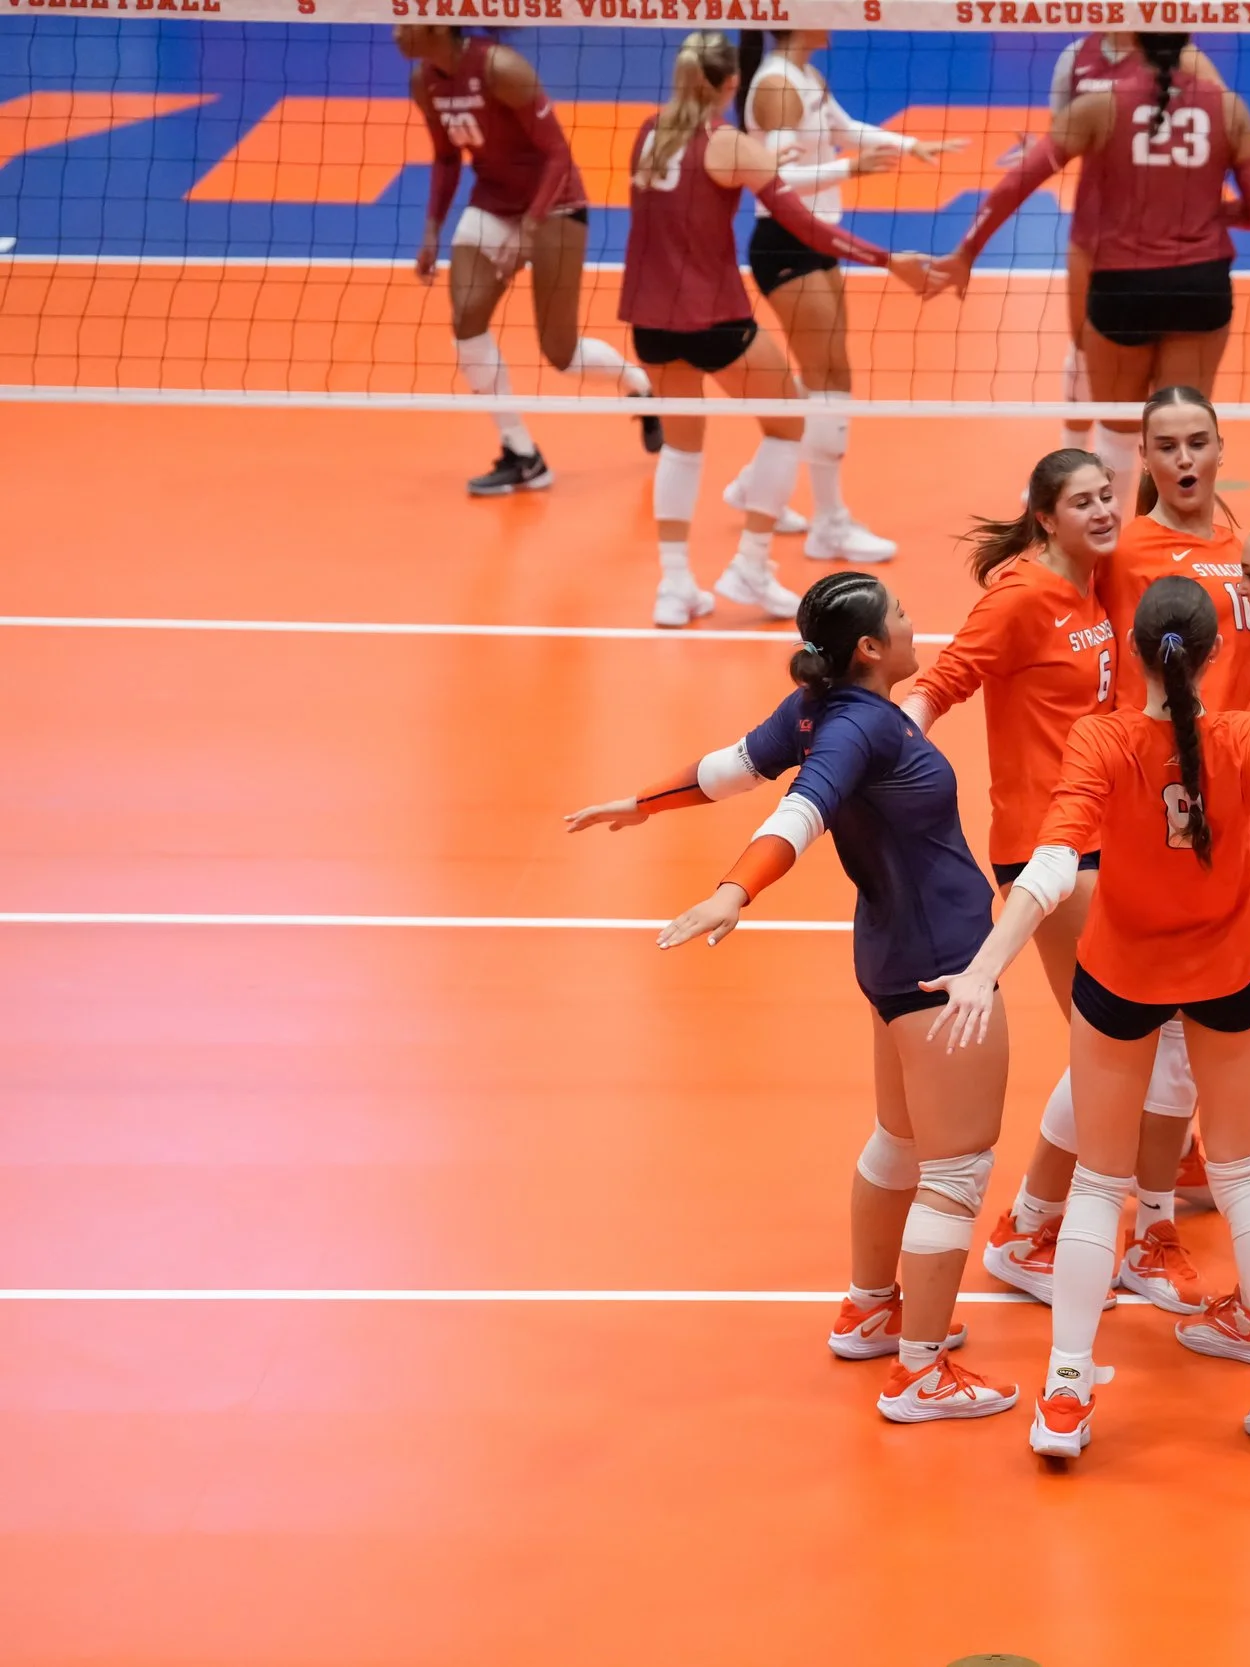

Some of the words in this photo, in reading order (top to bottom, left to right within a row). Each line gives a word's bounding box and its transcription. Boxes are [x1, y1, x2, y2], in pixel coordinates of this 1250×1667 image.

[392, 0, 562, 18] SYRACUSE
[577, 0, 789, 21] VOLLEYBALL
[863, 0, 881, 22] S
[956, 1, 1124, 25] SYRACUSE
[1131, 104, 1212, 168] 23
[1191, 562, 1244, 578] SYRACU
[1067, 618, 1116, 653] SYRACUS
[1096, 648, 1113, 704] 6
